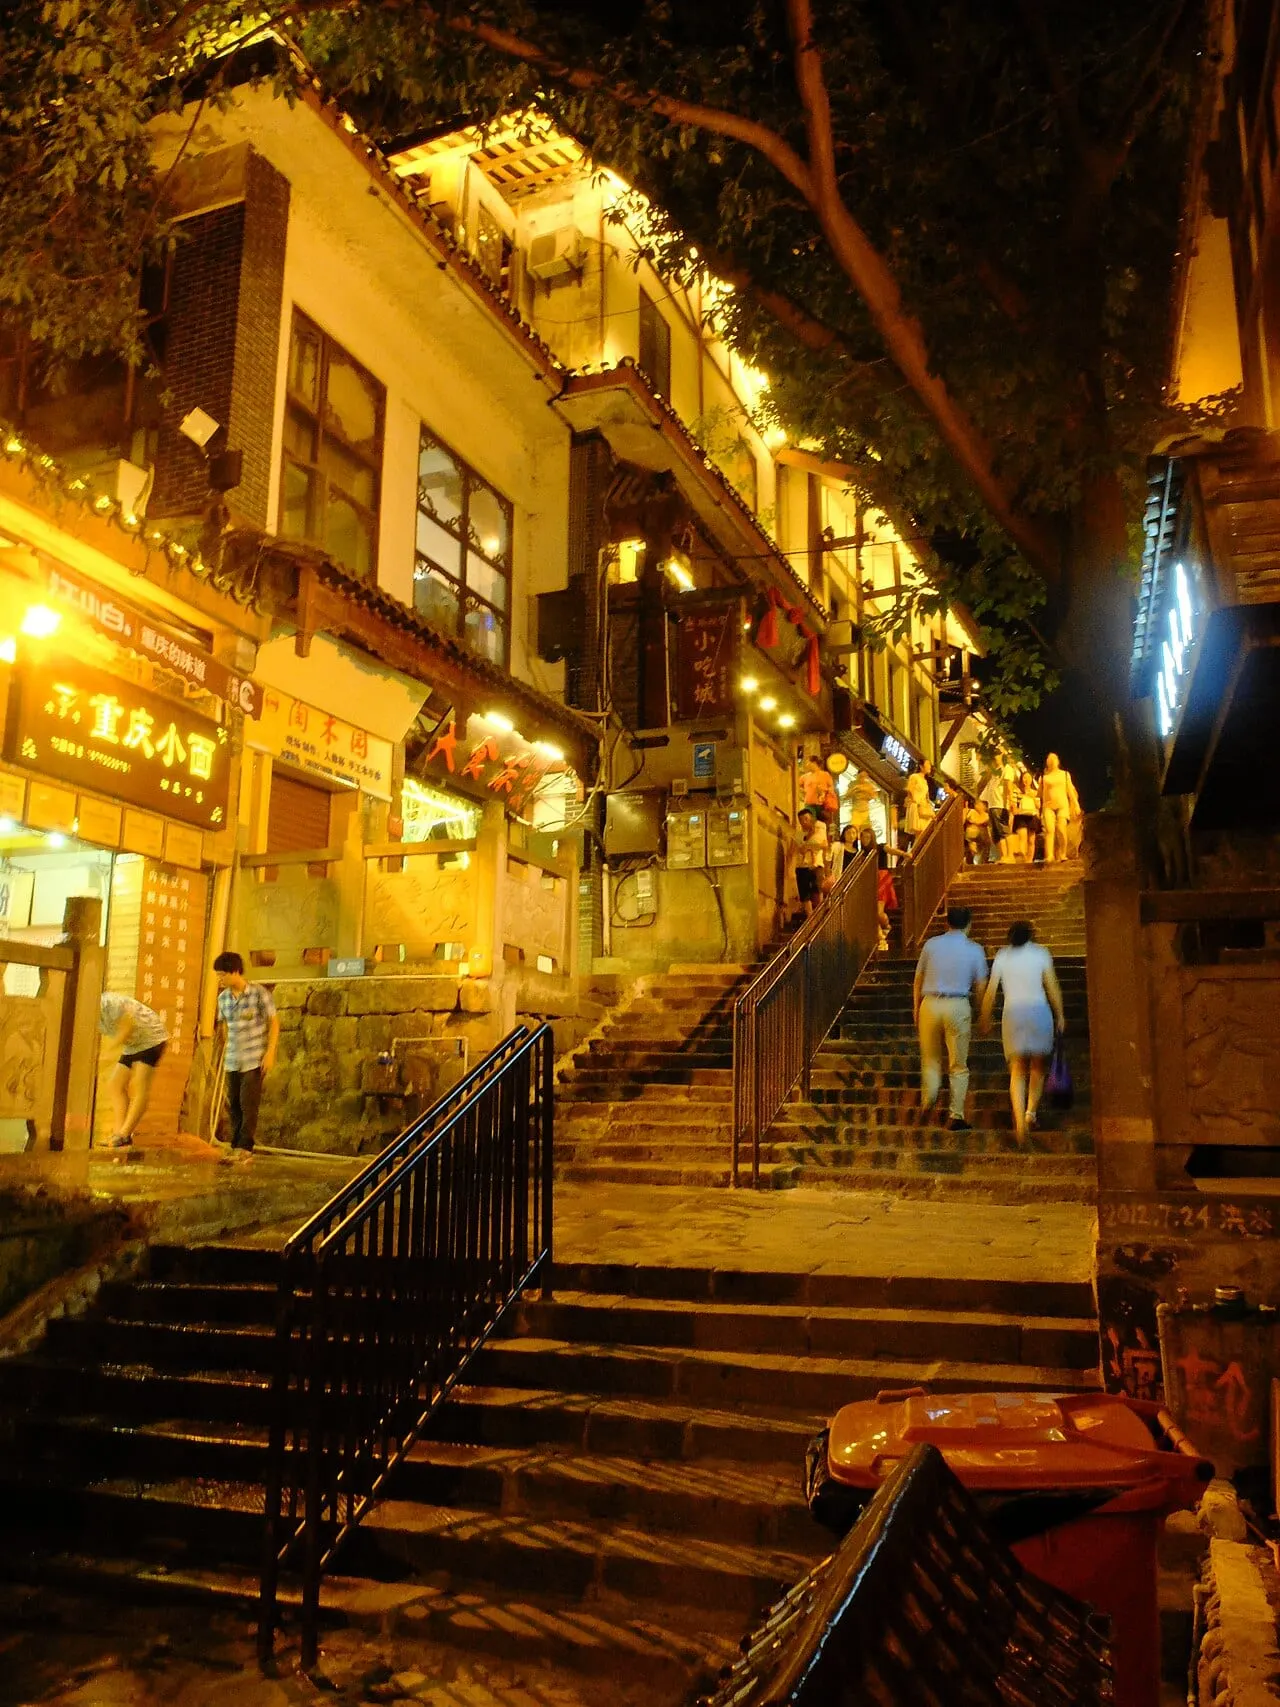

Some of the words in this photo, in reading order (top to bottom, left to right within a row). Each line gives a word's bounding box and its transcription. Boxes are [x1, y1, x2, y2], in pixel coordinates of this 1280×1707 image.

[142, 626, 206, 682] 重庆的味道
[694, 631, 716, 703] 小吃城
[89, 692, 217, 780] 重庆小面
